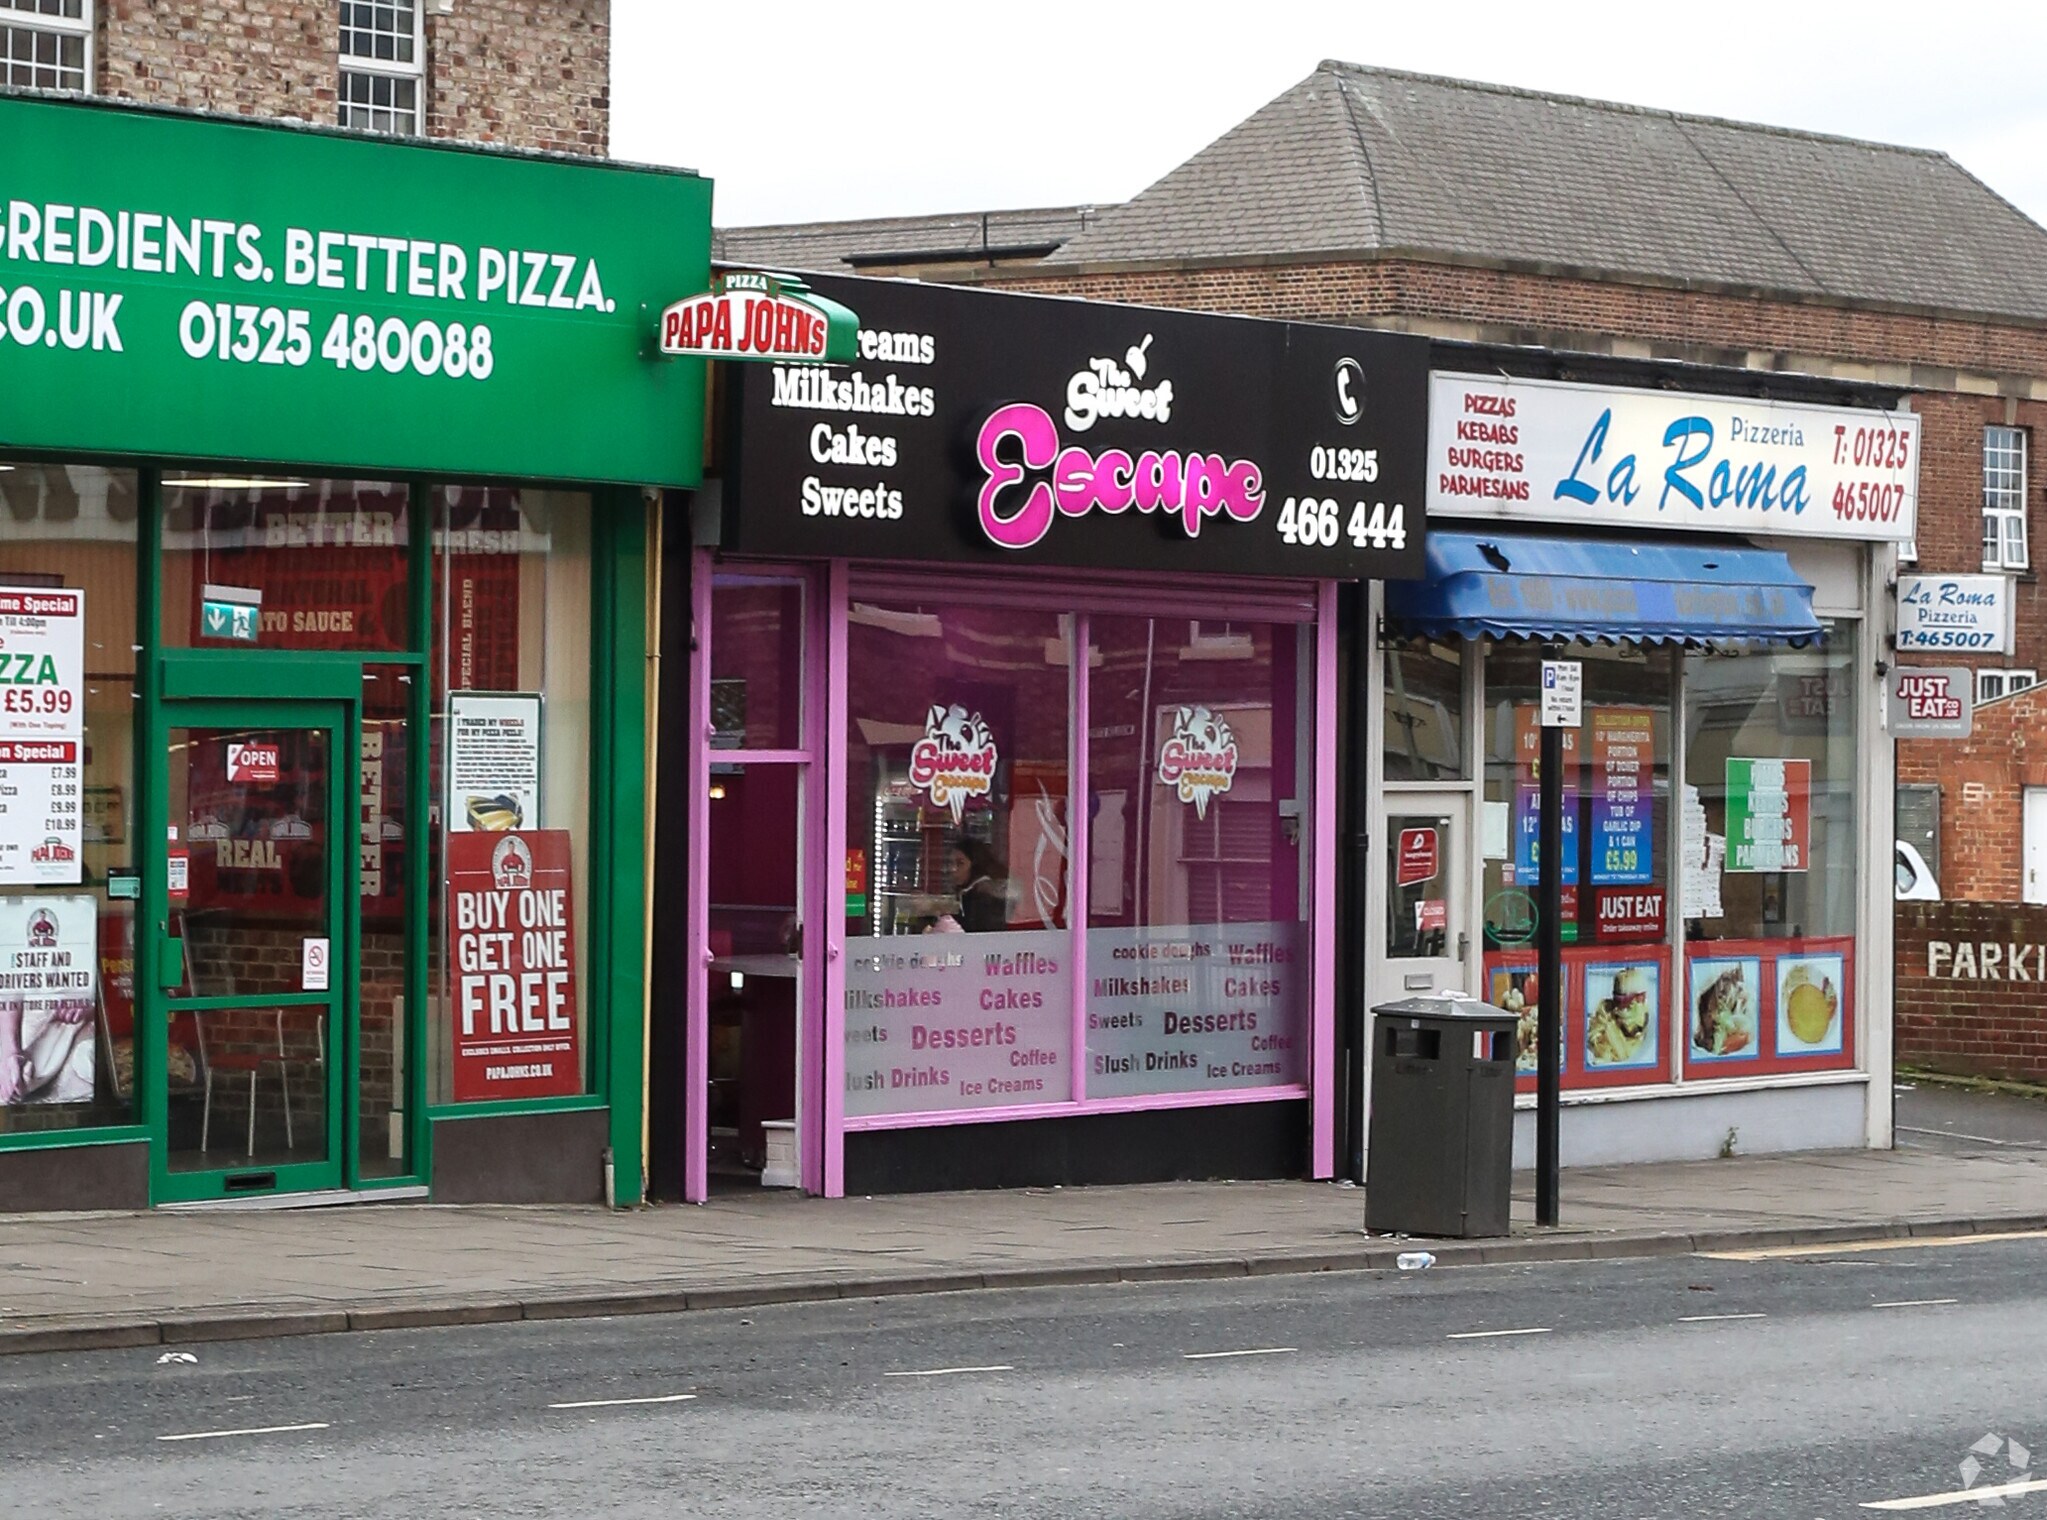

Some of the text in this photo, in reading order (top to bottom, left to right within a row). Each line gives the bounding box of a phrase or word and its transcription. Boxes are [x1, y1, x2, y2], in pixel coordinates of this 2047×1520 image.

[0, 200, 616, 314] REDIENTS. BETTER PIZZA.
[725, 274, 768, 290] PIZZA
[0, 285, 494, 380] O.UK 01325 480088
[665, 299, 825, 355] PAPA JOHNS
[1088, 356, 1132, 389] The
[771, 367, 935, 417] Milkshakes
[1063, 370, 1175, 432] Sweet
[1464, 393, 1517, 418] PIZZAS
[1457, 420, 1519, 445] KEBABS
[1730, 416, 1805, 448] Pizzeria
[810, 422, 897, 467] Cakes
[1833, 425, 1911, 470] T: 01325
[1310, 446, 1378, 483] 01325
[1448, 446, 1524, 473] BURGERS
[1553, 407, 1811, 516] La Roma
[976, 402, 1266, 549] Escape
[1439, 473, 1530, 501] PARMESANS
[801, 476, 904, 520] Sweets
[1832, 481, 1904, 523] 465007
[266, 511, 395, 547] BETTER
[1276, 496, 1406, 549] 466 444
[23, 596, 74, 614] Special
[461, 578, 474, 629] BLEND
[1902, 581, 1996, 606] La Roma
[293, 611, 353, 632] SAUCE
[1917, 607, 1978, 624] Pizzeria
[1546, 669, 1554, 687] P
[1898, 678, 1948, 697] JUST
[4, 689, 73, 714] £5.99
[1910, 698, 1948, 717] EAT
[14, 744, 65, 762] Special
[932, 731, 962, 752] The
[1179, 732, 1206, 752] The
[1607, 745, 1637, 757] PORTION
[240, 750, 277, 767] OPEN
[912, 742, 995, 783] Sweet
[1161, 742, 1235, 781] Sweet
[1605, 760, 1615, 772] OF
[1607, 775, 1637, 787] PORTION
[1606, 790, 1638, 802] OF CHIPS
[1610, 805, 1635, 817] TUB OF
[1603, 820, 1642, 832] GARLIC DIP
[1621, 835, 1636, 847] CAN
[216, 839, 283, 869] REAL
[1606, 850, 1638, 871] £5.99
[457, 889, 567, 930] BUY ONE
[1600, 896, 1634, 919] JUST
[1636, 895, 1663, 918] EAT
[16, 952, 48, 968] STAFF
[51, 951, 72, 967] AND
[459, 929, 568, 972] GET ONE
[1112, 941, 1211, 961] cookie doughs
[1228, 942, 1296, 965] Waffles
[983, 952, 1059, 976] Waffles
[0, 972, 43, 989] DRIVERS
[45, 971, 90, 988] WANTED
[1093, 976, 1190, 997] Milkshakes
[1224, 976, 1281, 998] Cakes
[461, 971, 571, 1036] FREE
[843, 988, 942, 1011] ilkshakes
[978, 988, 1043, 1010] Cakes
[1088, 1011, 1143, 1030] Sweets
[1163, 1009, 1257, 1035] Desserts
[911, 1022, 1017, 1050] Desserts
[1251, 1034, 1293, 1052] Coffee
[1009, 1050, 1057, 1067] Coffee
[1094, 1050, 1198, 1075] Slush Drinks
[1206, 1060, 1282, 1078] Ice Creams
[845, 1066, 950, 1092] lush Drinks
[960, 1077, 1044, 1096] Ice Creams
